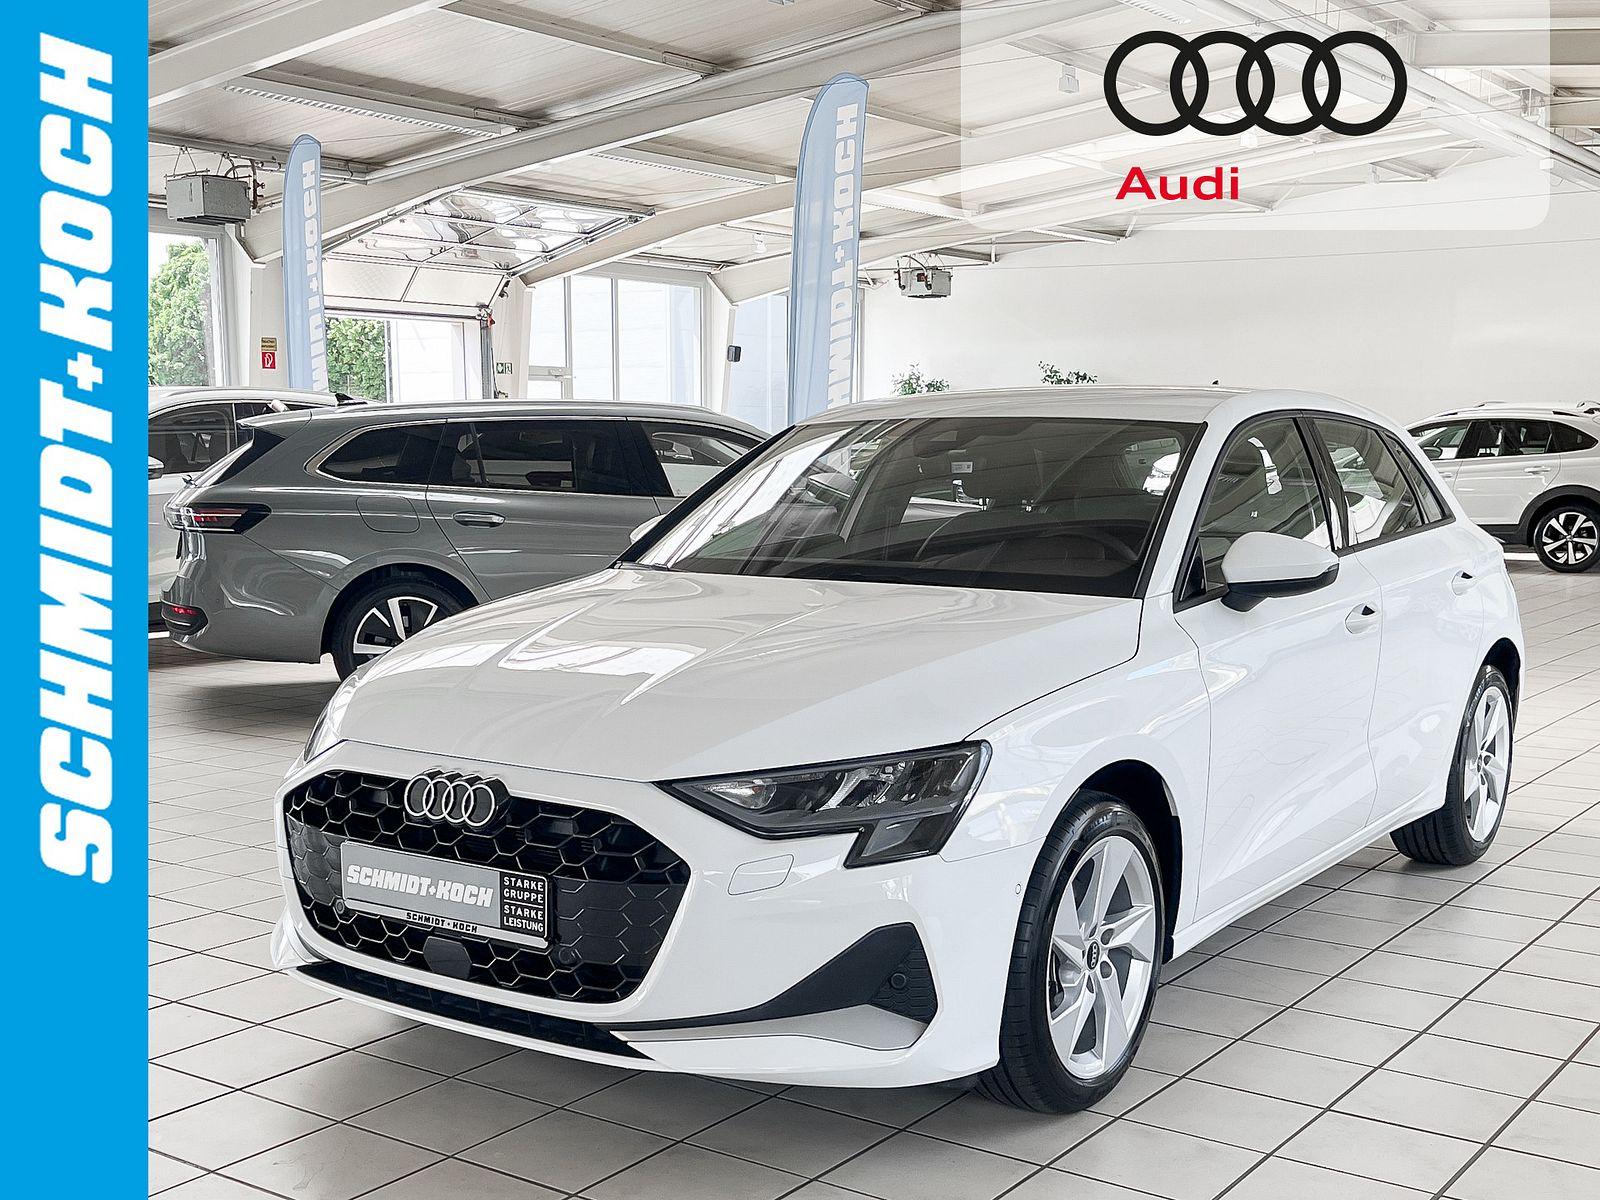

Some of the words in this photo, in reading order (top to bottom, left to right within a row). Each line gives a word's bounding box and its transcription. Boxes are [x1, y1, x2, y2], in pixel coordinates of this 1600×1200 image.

[346, 864, 494, 908] SCHMIDT+KOCH
[503, 876, 544, 892] STARKE
[503, 888, 544, 904] GRUPPE
[503, 904, 544, 920] STARKE
[406, 912, 446, 927] SCHMIDT
[452, 921, 478, 934] KOCH
[503, 916, 544, 932] LEISTUNG
